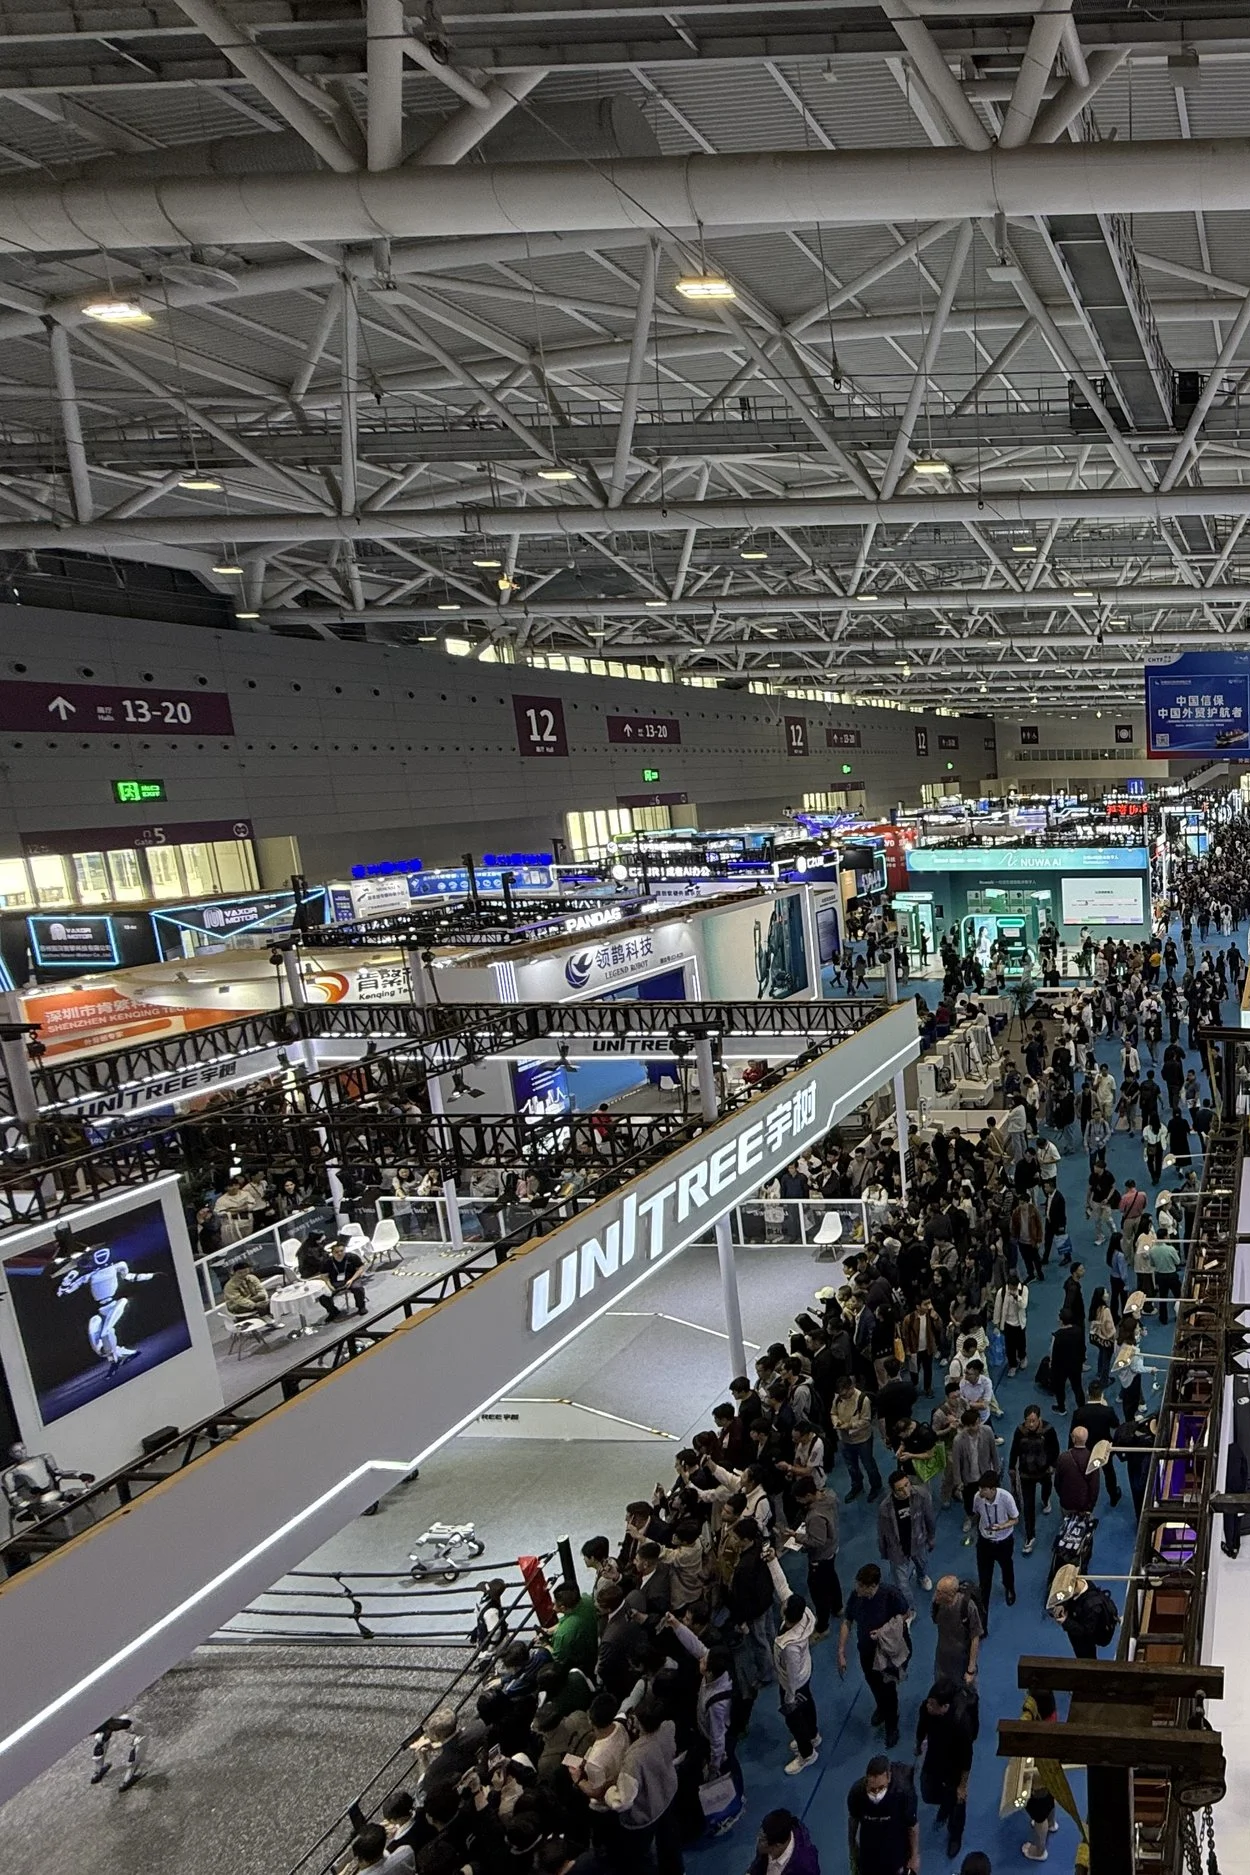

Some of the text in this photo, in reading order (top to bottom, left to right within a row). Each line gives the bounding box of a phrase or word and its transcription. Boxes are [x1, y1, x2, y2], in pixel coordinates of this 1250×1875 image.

[1176, 695, 1224, 707] 中国信保
[122, 699, 192, 724] 13-20
[1158, 707, 1242, 719] 中国外贸护航者
[526, 708, 558, 742] 12
[645, 724, 668, 738] 13-20
[790, 724, 804, 746] 12
[917, 732, 926, 749] 12
[135, 838, 153, 846] Gate
[153, 828, 167, 844] 5
[1021, 858, 1061, 867] NUWA AI
[225, 914, 259, 925] MOTOR
[595, 936, 653, 969] 领鹊科技
[605, 960, 648, 980] LEGEND ROBOT
[359, 990, 395, 1000] Kenqing
[48, 1016, 107, 1033] SHENZHEN
[110, 1008, 160, 1022] KENQING
